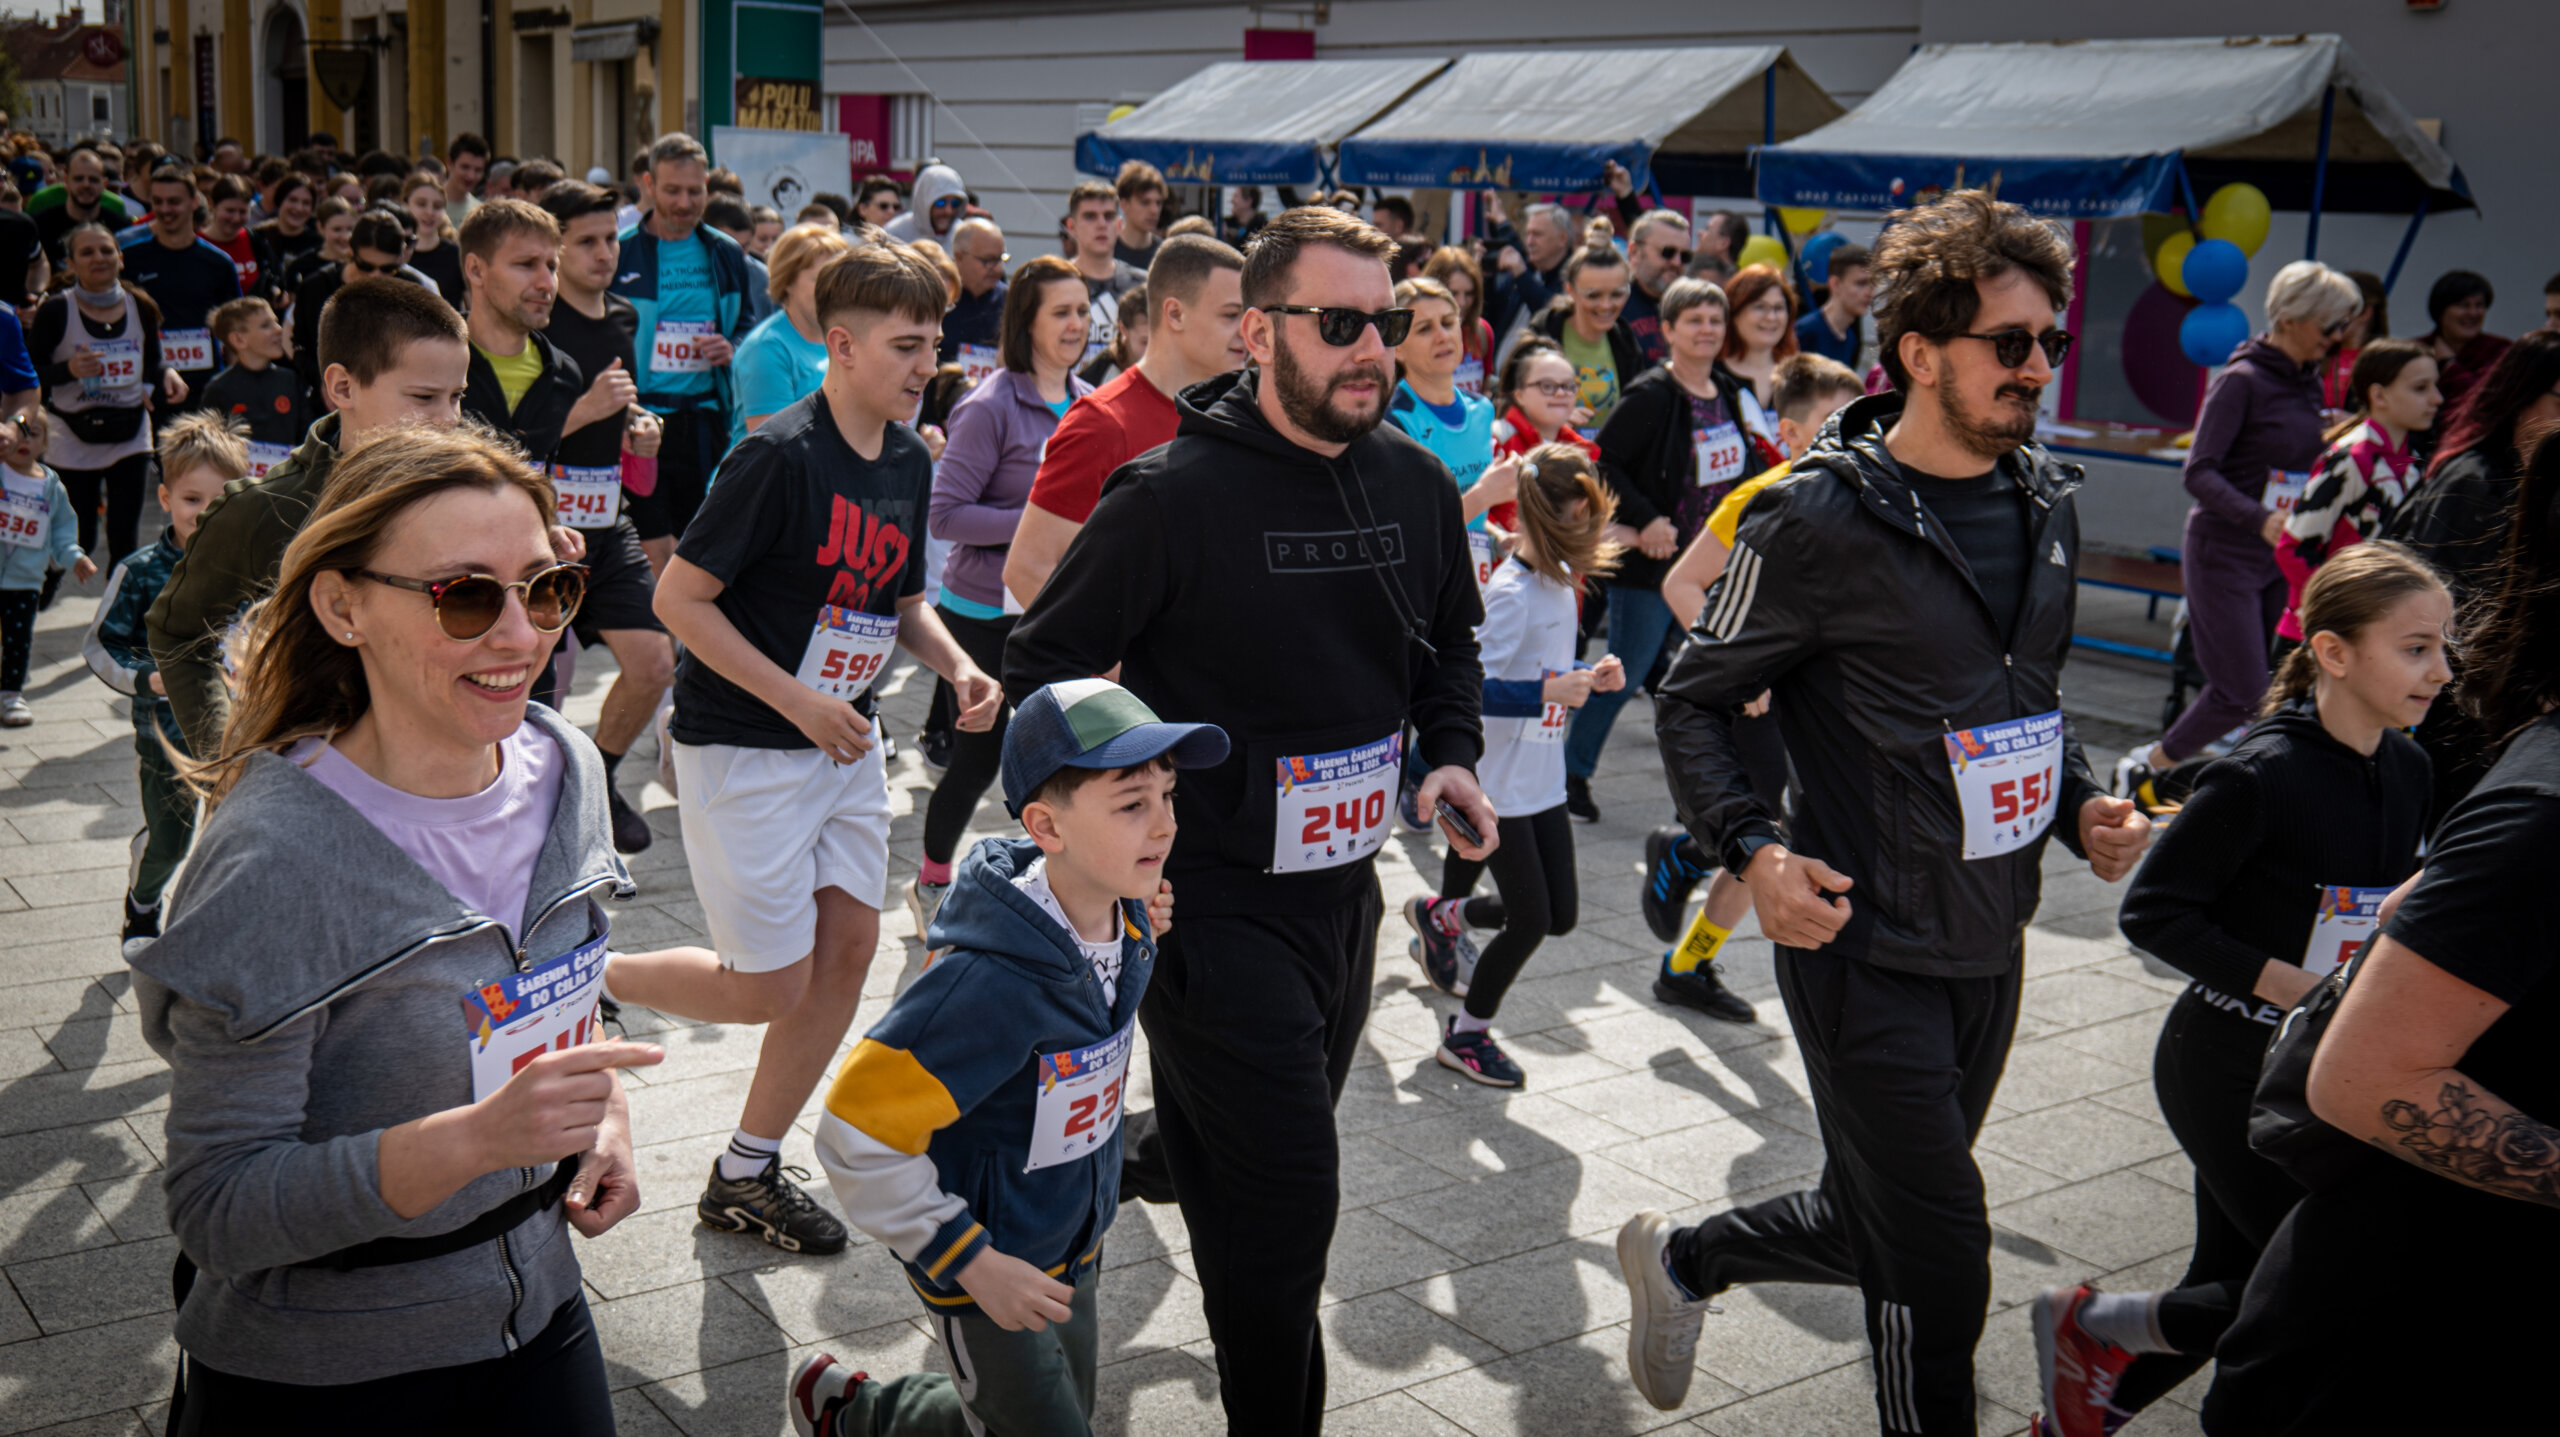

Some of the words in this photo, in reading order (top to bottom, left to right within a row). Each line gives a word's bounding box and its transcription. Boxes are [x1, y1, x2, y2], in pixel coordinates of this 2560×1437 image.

[760, 83, 811, 111] POLU
[1710, 445, 1740, 470] 212
[557, 493, 607, 514] 241
[816, 492, 909, 590] JUST
[820, 649, 884, 681] 599
[1321, 768, 1335, 781] DO
[1990, 765, 2053, 824] 551
[1301, 789, 1386, 845] 240
[516, 962, 570, 997] ŠARENIM
[530, 988, 551, 1010] DO
[554, 970, 588, 999] CILJA
[1088, 1058, 1104, 1072] DO
